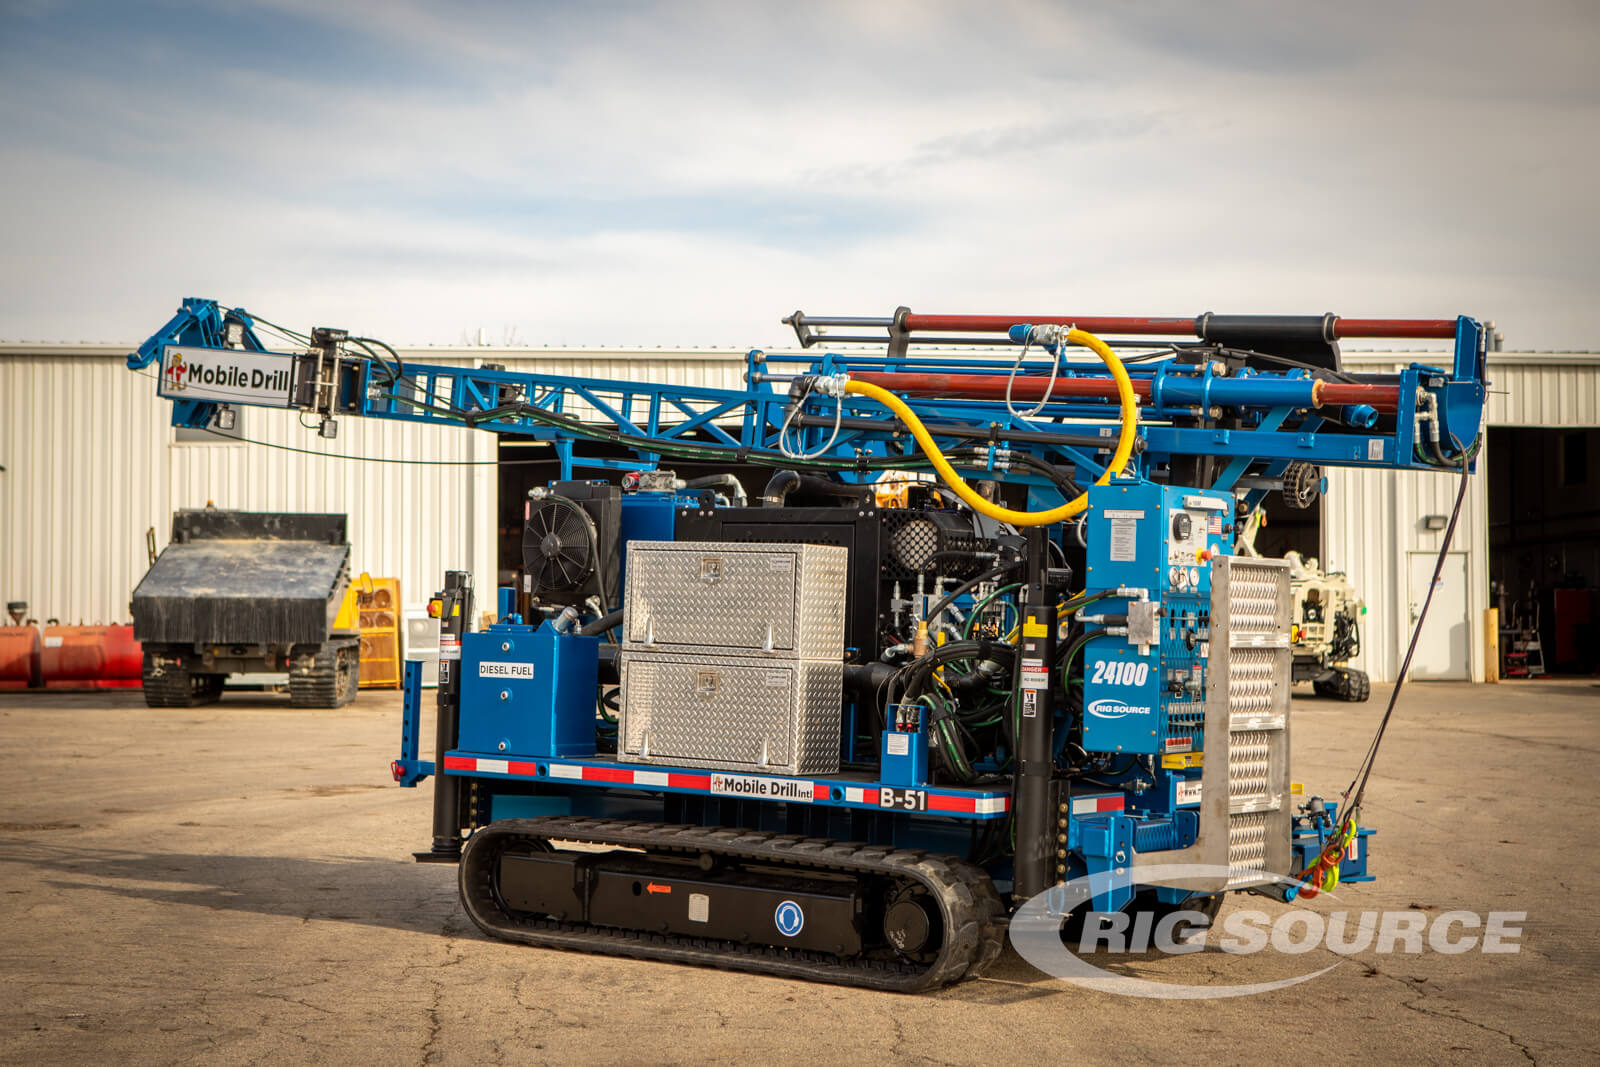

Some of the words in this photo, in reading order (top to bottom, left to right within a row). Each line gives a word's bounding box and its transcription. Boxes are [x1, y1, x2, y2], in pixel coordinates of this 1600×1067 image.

[188, 363, 249, 388] Mobile
[251, 369, 289, 392] Drill
[480, 665, 509, 675] DIESEL
[511, 666, 533, 676] FUEL
[1091, 660, 1149, 687] 24100
[1096, 704, 1112, 713] RIG
[1113, 705, 1151, 715] SOURCE
[724, 778, 767, 795] Mobile
[771, 781, 797, 798] Drill
[880, 787, 926, 811] B-51
